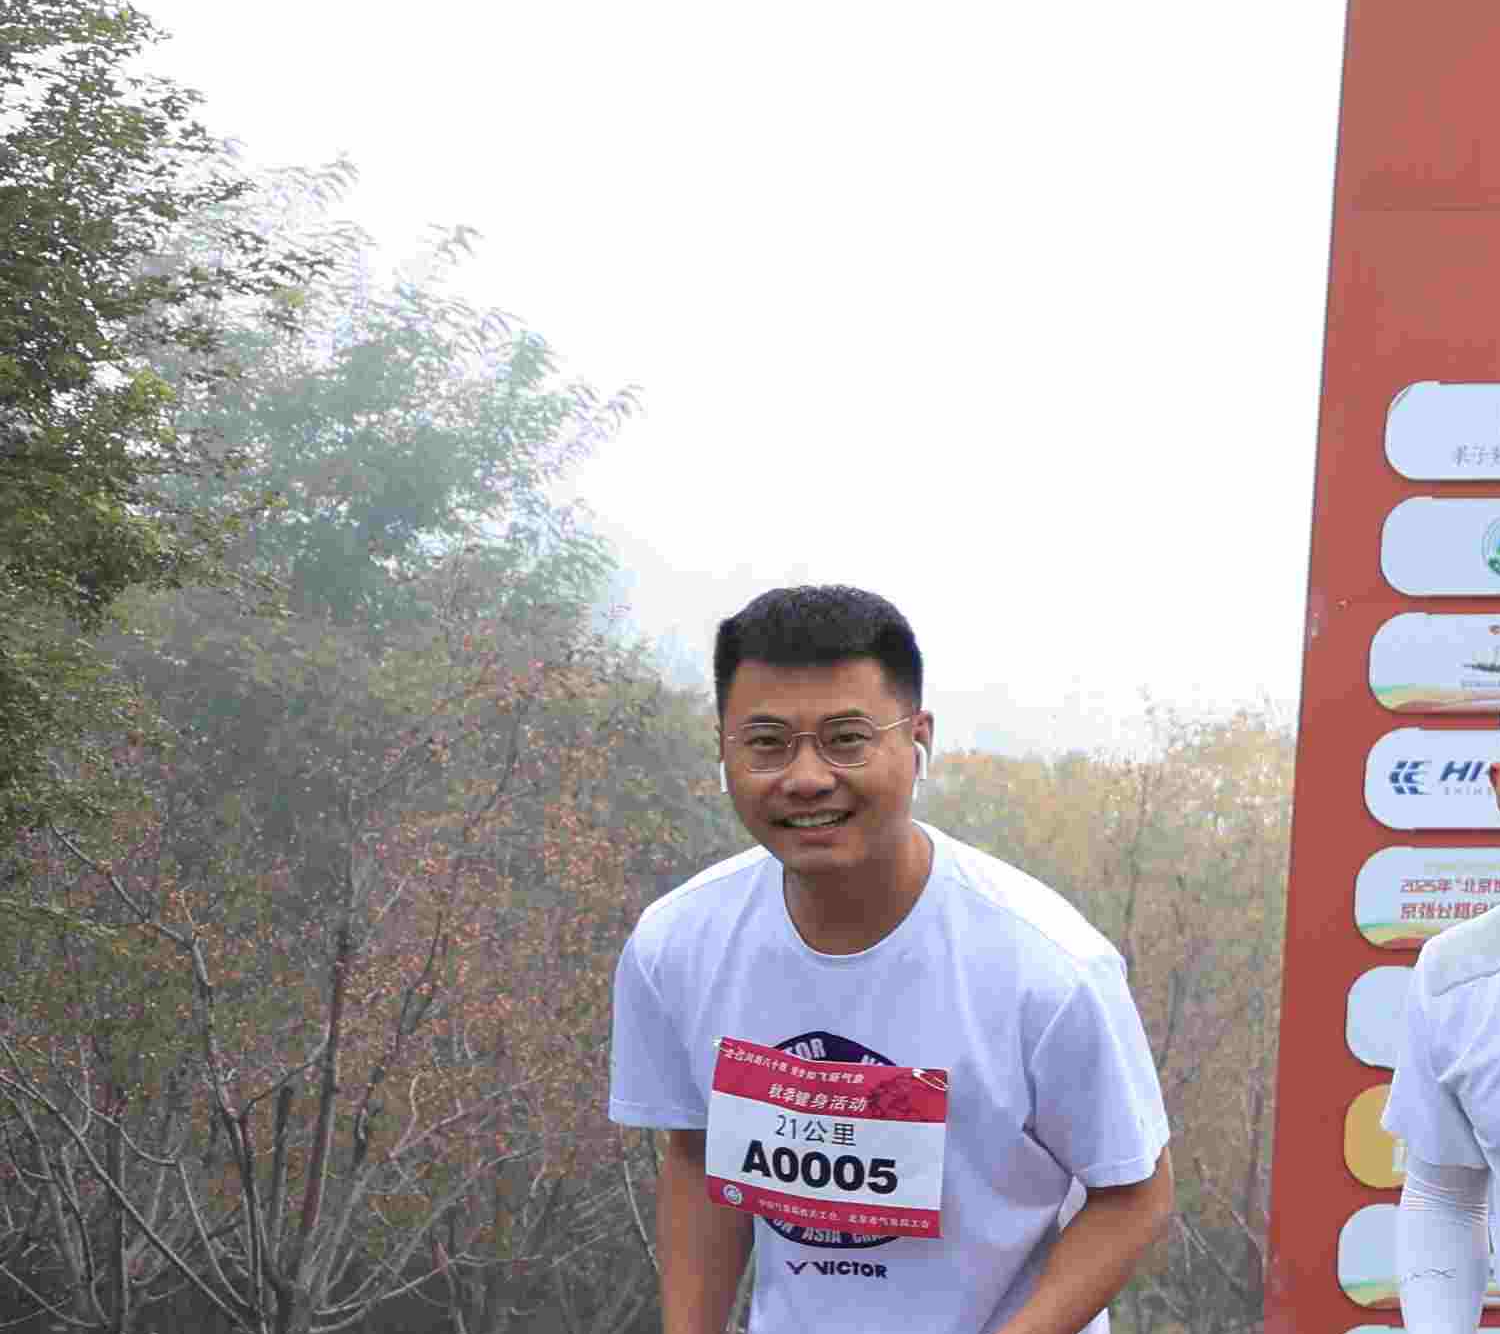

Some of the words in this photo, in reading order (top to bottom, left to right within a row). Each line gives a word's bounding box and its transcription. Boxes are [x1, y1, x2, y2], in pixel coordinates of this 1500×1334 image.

[775, 1114, 857, 1147] 21公里
[741, 1139, 899, 1195] A0005
[811, 1260, 888, 1279] VICTOR
